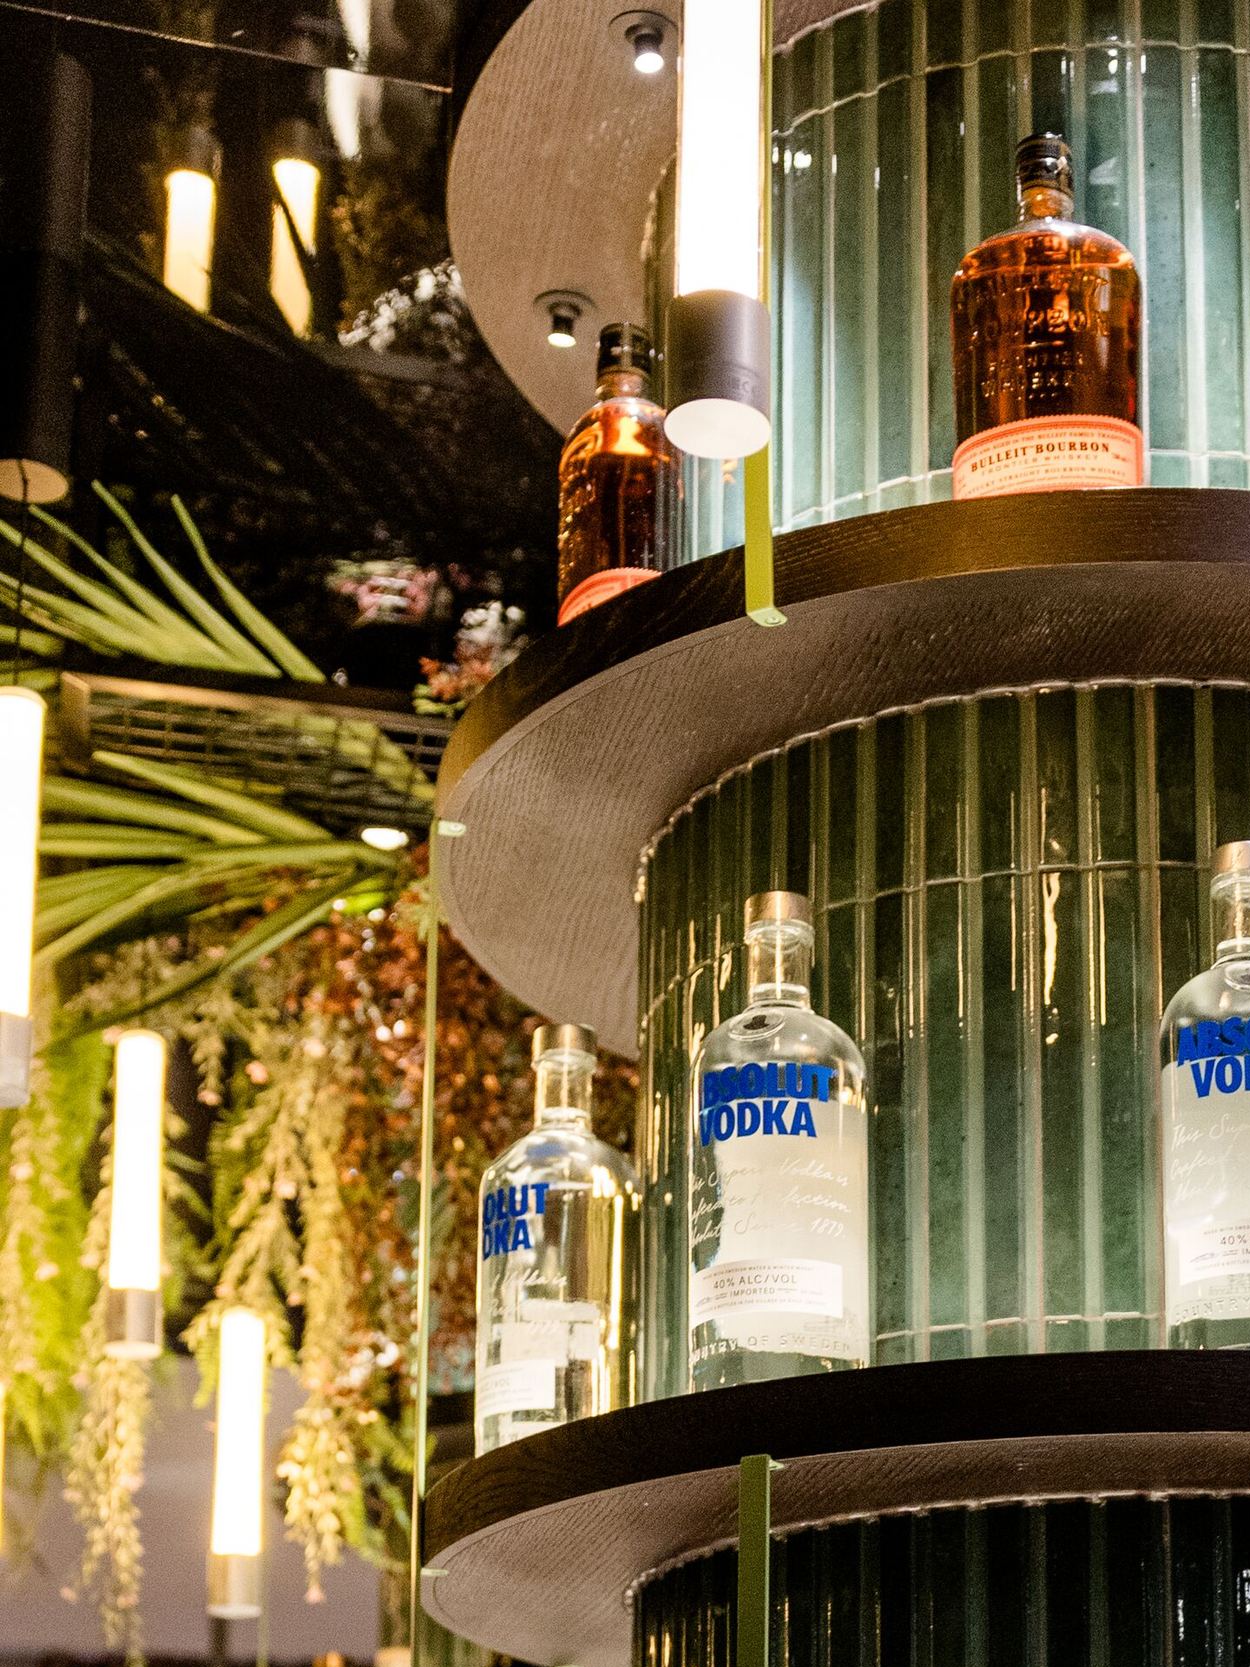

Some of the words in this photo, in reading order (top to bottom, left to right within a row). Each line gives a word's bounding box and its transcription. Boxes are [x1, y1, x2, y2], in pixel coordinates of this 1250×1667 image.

[971, 447, 1027, 473] BULLEIT
[1035, 442, 1110, 454] BOURBON
[703, 1062, 834, 1108] BSOLUT
[700, 1100, 818, 1147] VODKA
[483, 1183, 550, 1225] OLUT
[483, 1218, 534, 1262] DKA
[1220, 1234, 1248, 1246] 40%
[713, 1277, 735, 1290] 40%
[738, 1274, 798, 1286] ALC/VOL
[729, 1288, 776, 1298] IMPORTED
